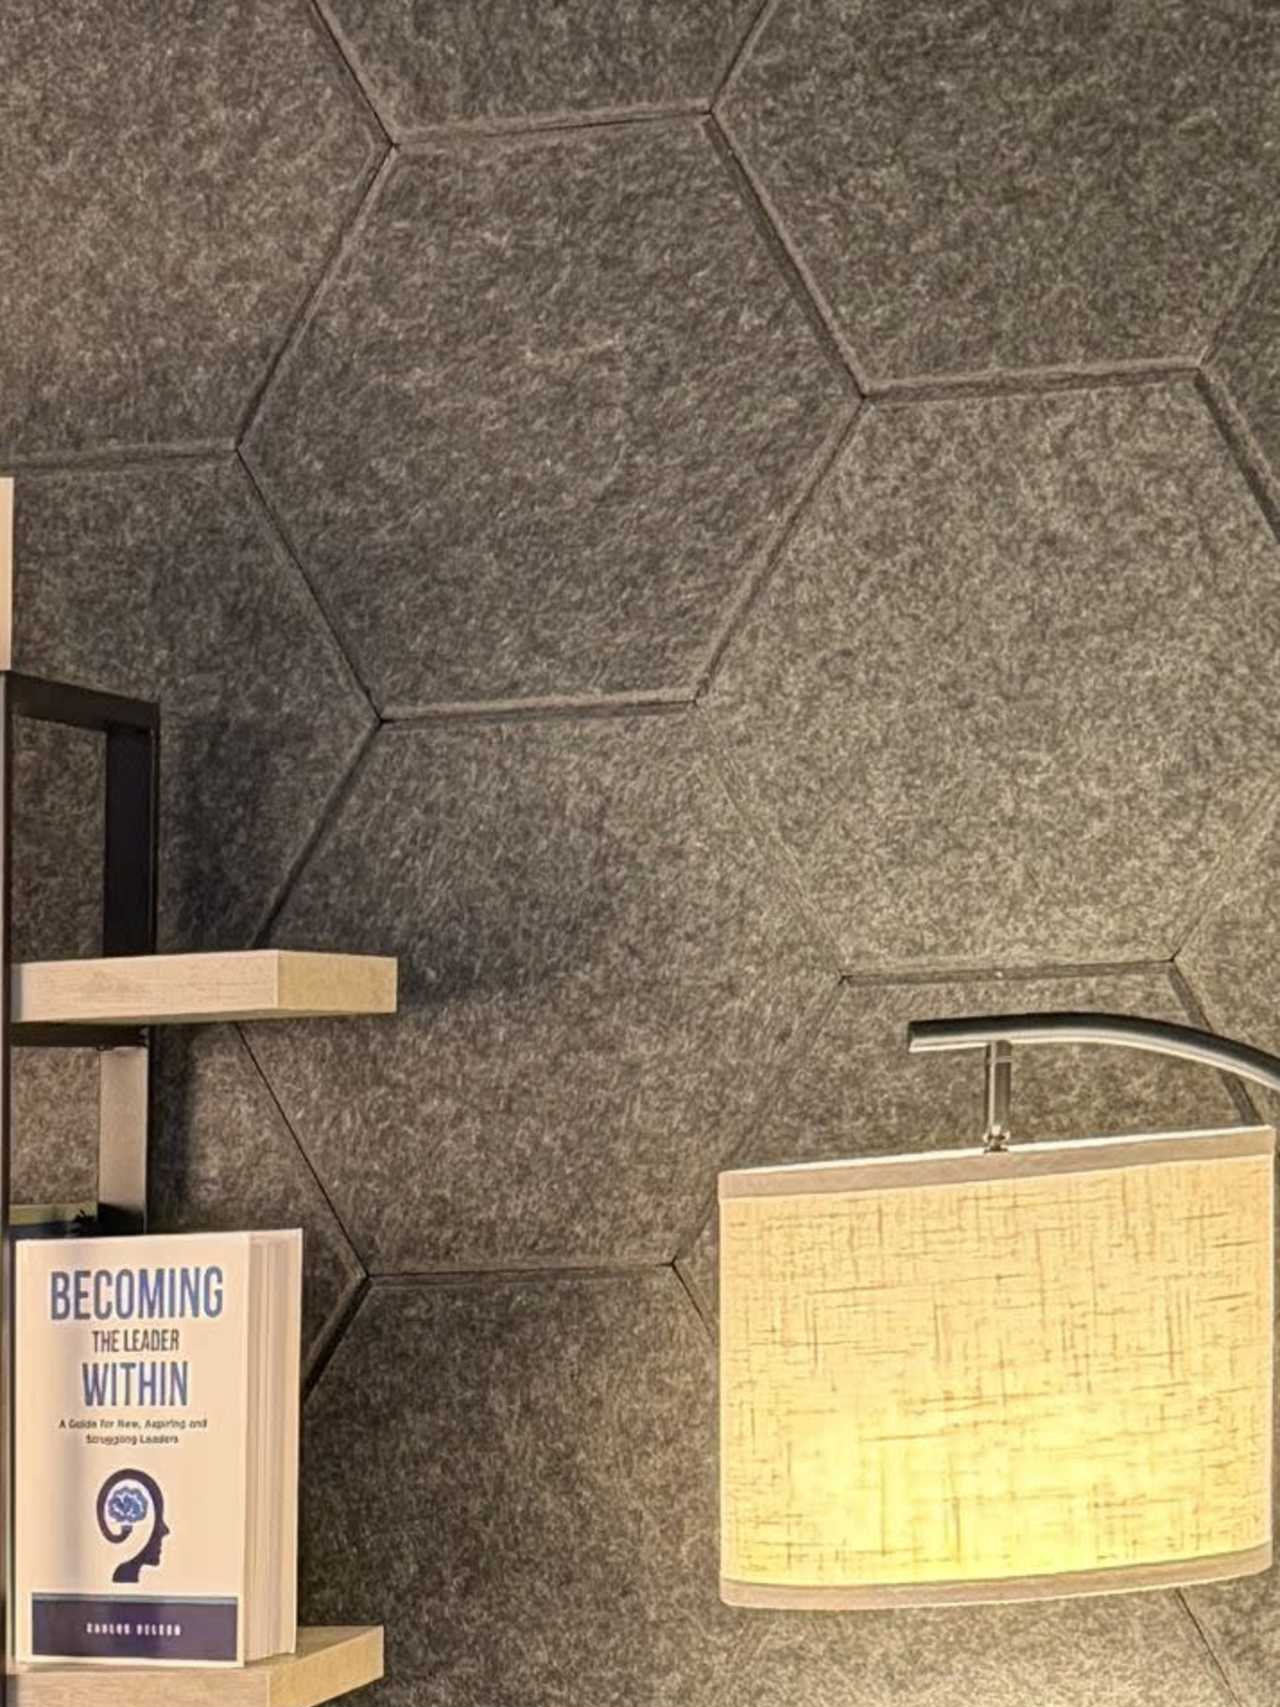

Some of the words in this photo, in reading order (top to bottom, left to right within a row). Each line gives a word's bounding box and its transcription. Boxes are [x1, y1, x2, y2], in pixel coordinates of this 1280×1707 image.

[50, 1266, 223, 1321] BECOMING
[92, 1330, 119, 1353] THE
[123, 1329, 180, 1352] LEADER
[82, 1361, 188, 1407] WITHIN
